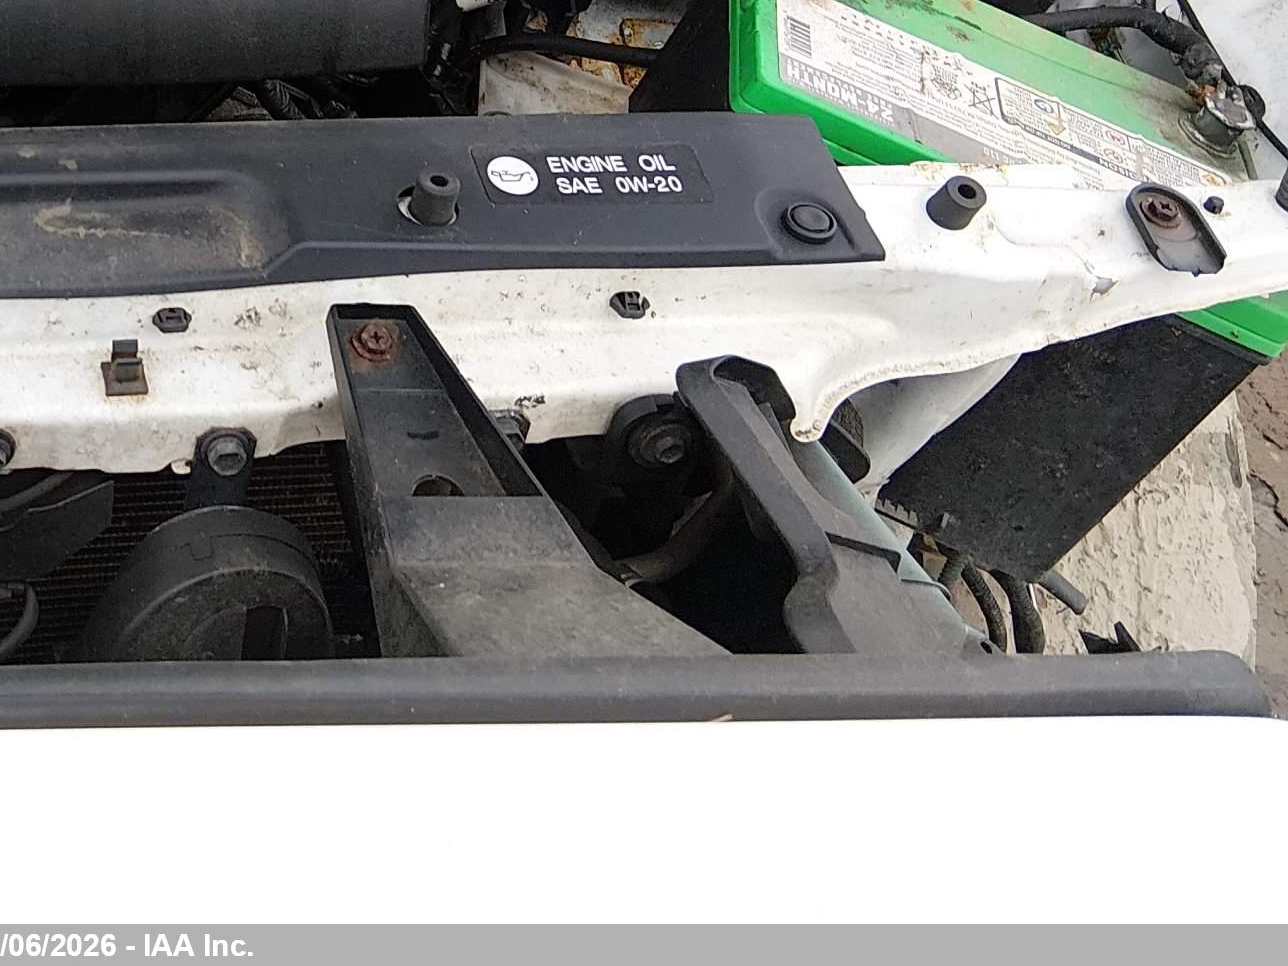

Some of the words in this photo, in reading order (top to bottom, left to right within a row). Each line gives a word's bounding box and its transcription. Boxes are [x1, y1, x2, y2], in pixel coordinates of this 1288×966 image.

[785, 62, 895, 123] 24-MONTH
[546, 155, 628, 173] ENGINE
[638, 154, 677, 172] OIL
[555, 177, 604, 194] SAE
[614, 175, 684, 194] 0W-20
